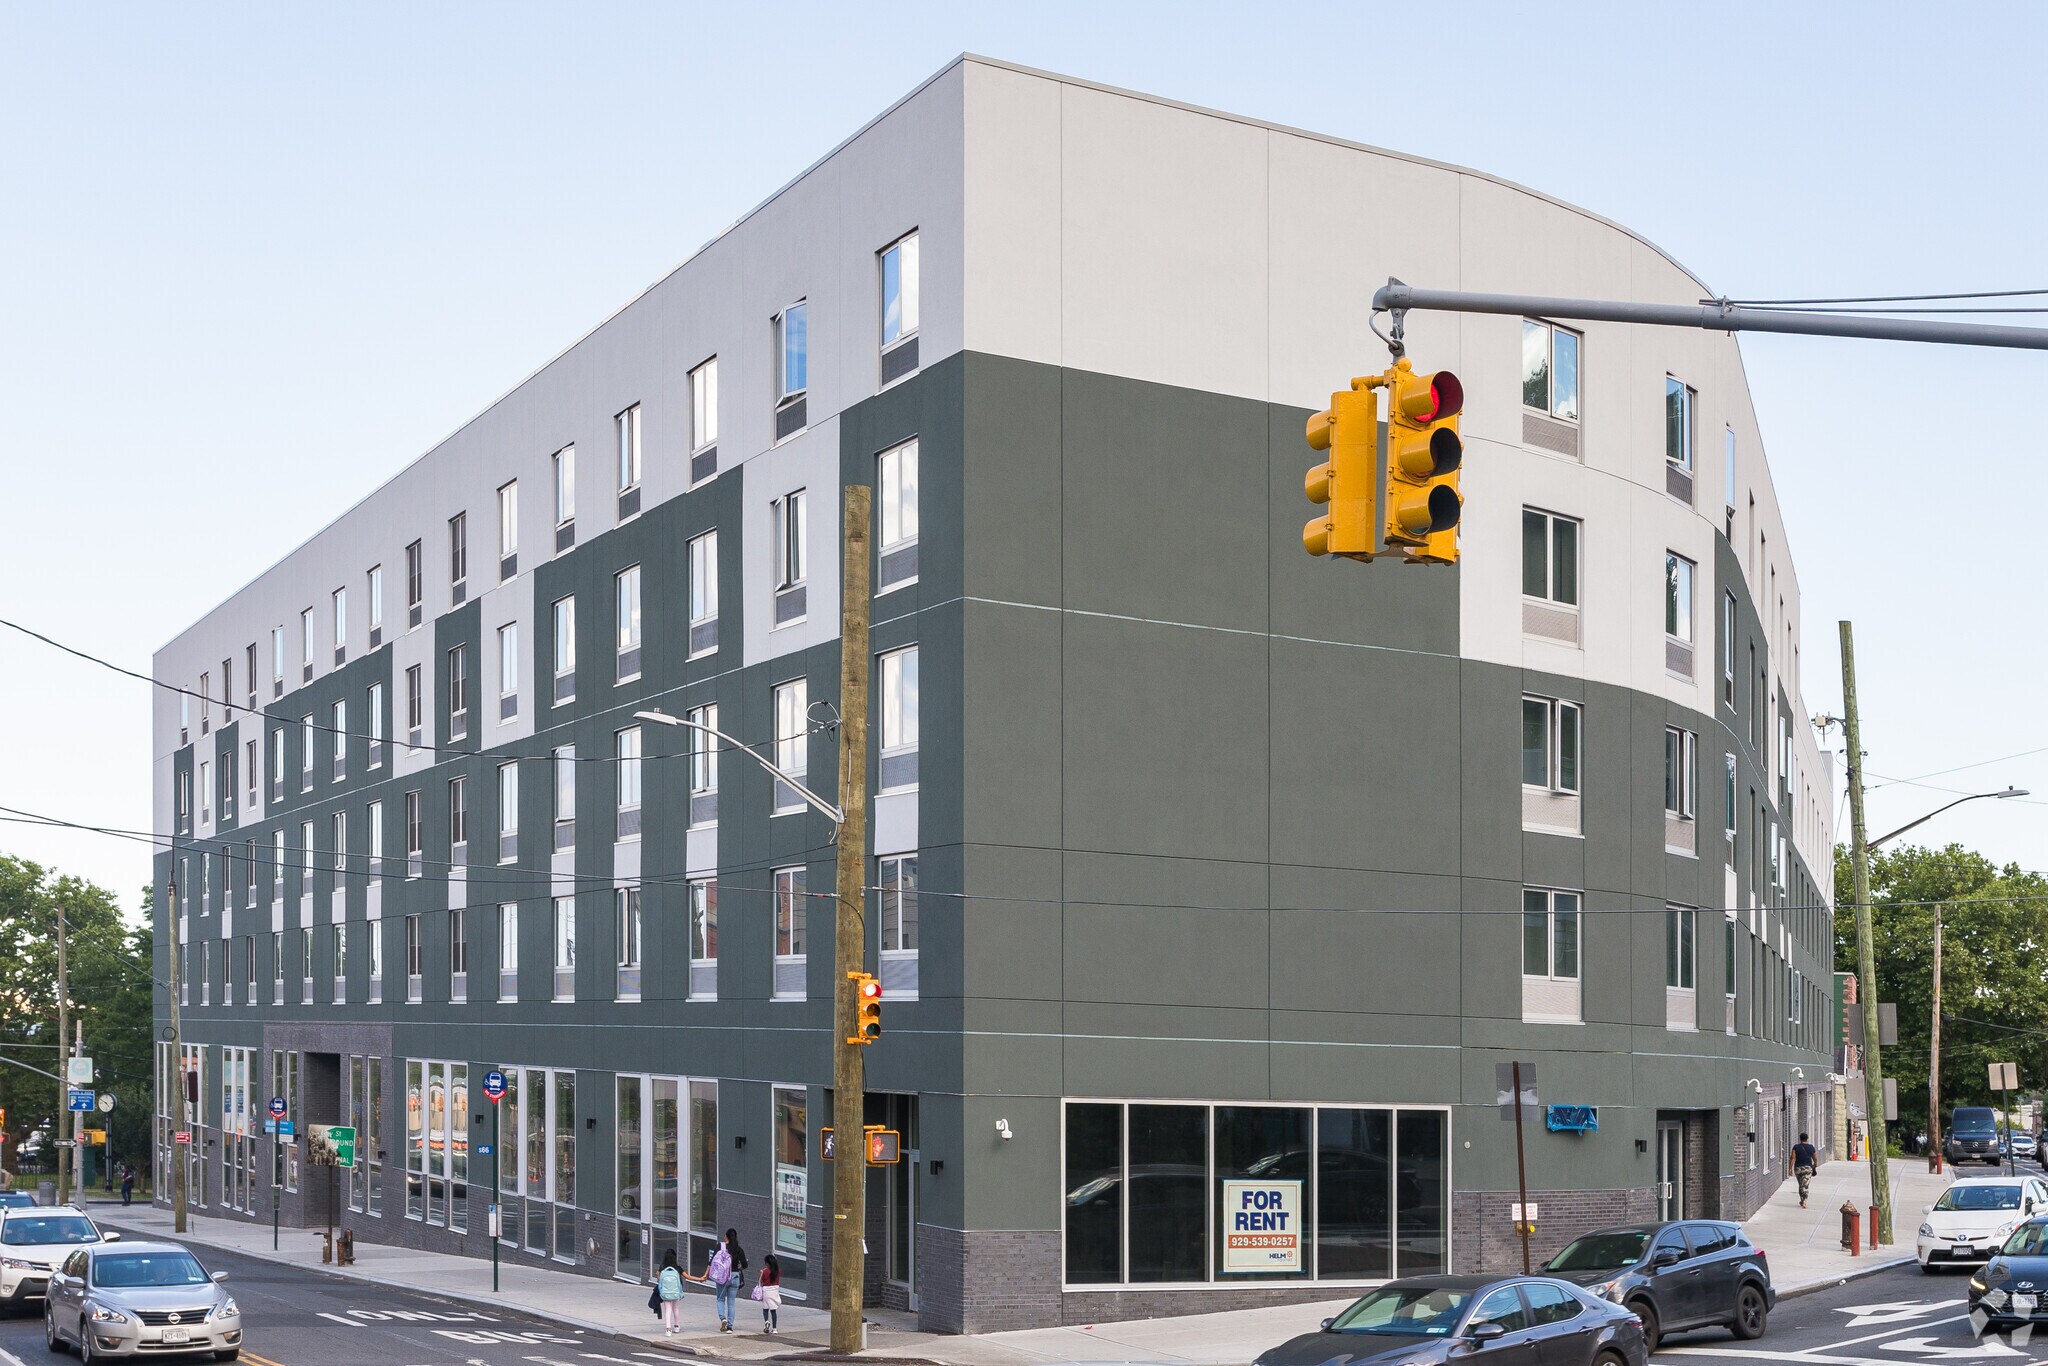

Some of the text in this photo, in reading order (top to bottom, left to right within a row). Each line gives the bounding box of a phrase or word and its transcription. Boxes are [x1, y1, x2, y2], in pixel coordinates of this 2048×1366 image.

[784, 1173, 801, 1194] FOR
[782, 1192, 805, 1214] RENT
[1242, 1191, 1282, 1210] FOR
[1235, 1212, 1289, 1231] RENT
[1231, 1237, 1294, 1247] 929-539-0257
[347, 1310, 501, 1322] ONLY
[430, 1330, 584, 1345] BUS
